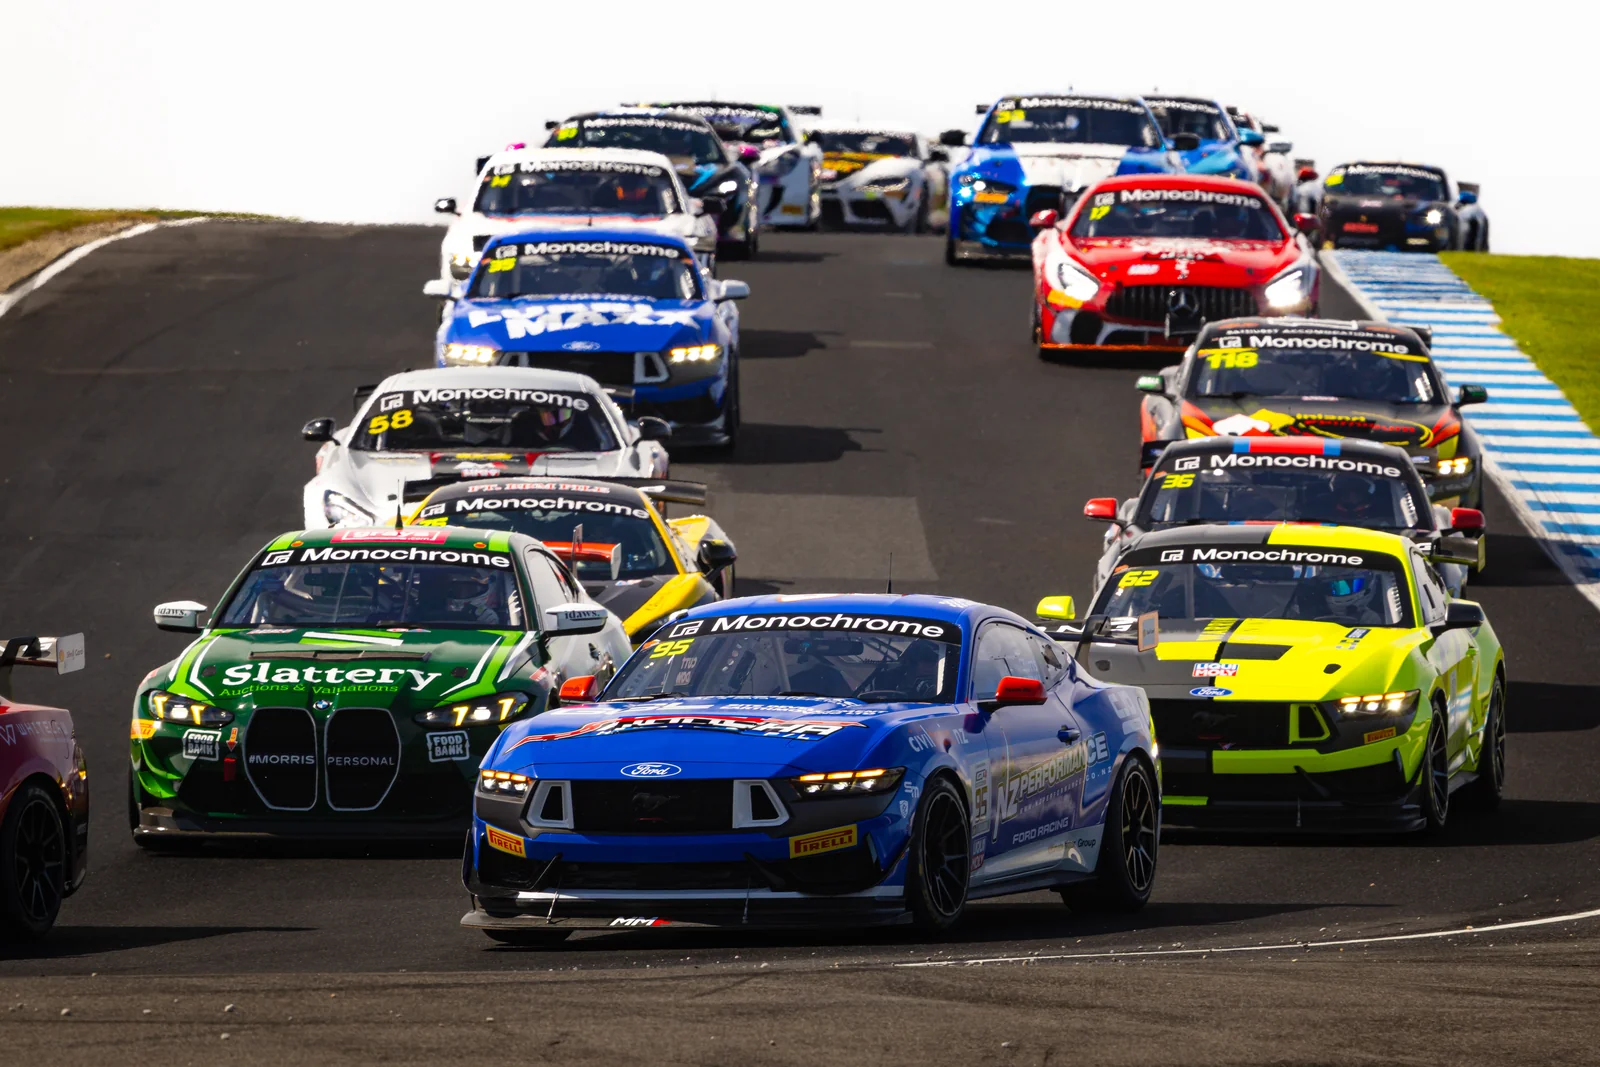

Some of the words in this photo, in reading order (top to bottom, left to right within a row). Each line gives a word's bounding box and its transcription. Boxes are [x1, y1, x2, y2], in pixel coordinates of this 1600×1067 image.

[521, 160, 663, 177] Monochrome
[1120, 188, 1262, 209] Monochrome
[525, 241, 678, 259] Monochrome
[1250, 335, 1409, 355] Monochrome
[1206, 352, 1259, 369] 118
[412, 389, 590, 412] Monochrome
[368, 409, 414, 435] 58
[1210, 454, 1402, 479] Monochrome
[1160, 474, 1197, 489] 36
[456, 496, 650, 520] Monochrome
[299, 547, 511, 569] Monochrome
[1191, 548, 1364, 567] Monochrome
[1118, 570, 1160, 588] 62
[564, 610, 601, 620] idaws.
[710, 613, 945, 638] Monochrome
[650, 638, 695, 659] 95
[1193, 669, 1237, 677] MOLY
[1195, 663, 1238, 671] LIQUI
[222, 662, 442, 692] Slattery
[219, 684, 289, 697] Auctions
[293, 684, 306, 692] &
[312, 684, 399, 695] Valuations
[1197, 687, 1226, 697] Ford
[188, 733, 214, 744] FOOD
[433, 735, 463, 746] FOOD
[188, 743, 214, 755] BANK
[434, 744, 464, 757] BANK
[249, 755, 315, 765] #MORRIS
[327, 756, 395, 766] PERSONAL
[631, 764, 671, 775] Ford
[1012, 828, 1037, 846] FORD
[1037, 817, 1069, 837] RACING
[489, 829, 522, 855] PIRELLI
[794, 830, 854, 855] PIRELLI
[1078, 838, 1097, 849] Group
